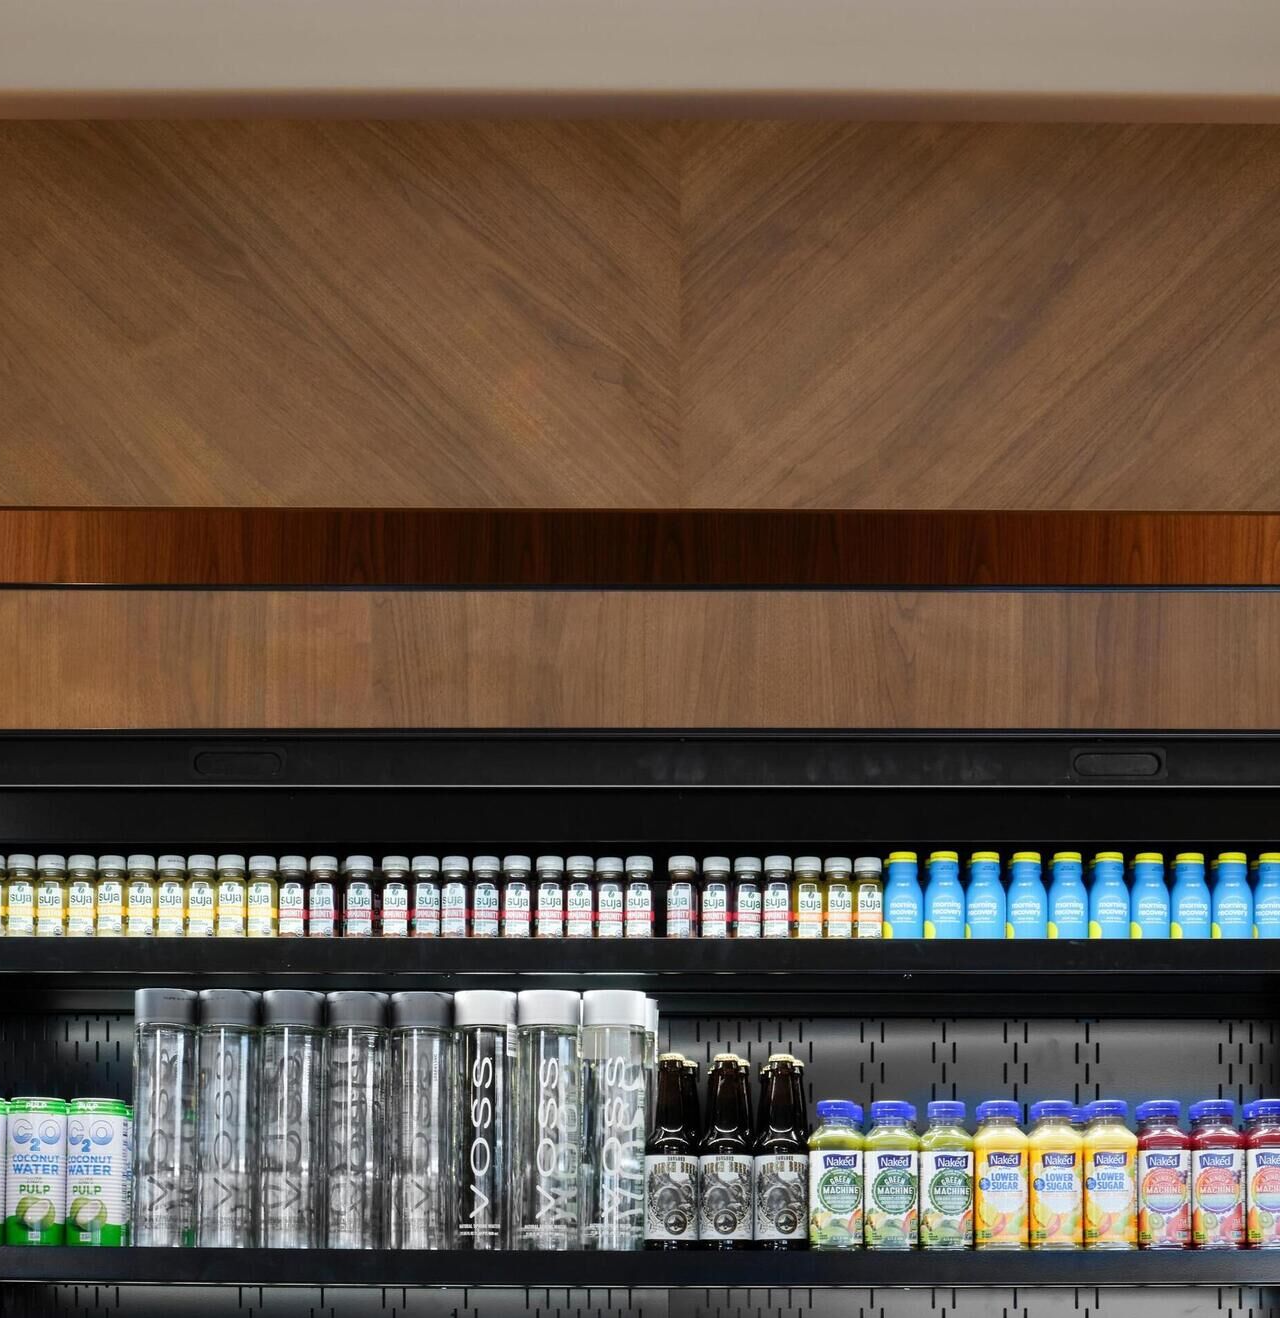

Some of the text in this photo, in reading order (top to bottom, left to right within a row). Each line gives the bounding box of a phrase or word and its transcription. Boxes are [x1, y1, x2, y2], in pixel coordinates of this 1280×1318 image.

[890, 901, 917, 910] morning
[1012, 901, 1040, 910] morning
[470, 1057, 493, 1218] VOSS
[536, 1057, 558, 1218] VOSS
[826, 1155, 855, 1167] Naked
[937, 1156, 966, 1168] Naked
[991, 1154, 1018, 1165] Naked
[1045, 1154, 1073, 1166] Naked
[13, 1165, 59, 1175] WATER
[829, 1176, 850, 1185] GREEN
[884, 1176, 905, 1185] GREEN
[992, 1173, 1019, 1182] LOWER
[1046, 1173, 1073, 1182] LOWER
[19, 1184, 50, 1194] PULP
[823, 1186, 859, 1195] MACHINE
[992, 1182, 1019, 1191] SUGAR
[1046, 1182, 1073, 1191] SUGAR
[1146, 1186, 1182, 1194] MACHINE
[878, 1187, 914, 1196] MACHINE
